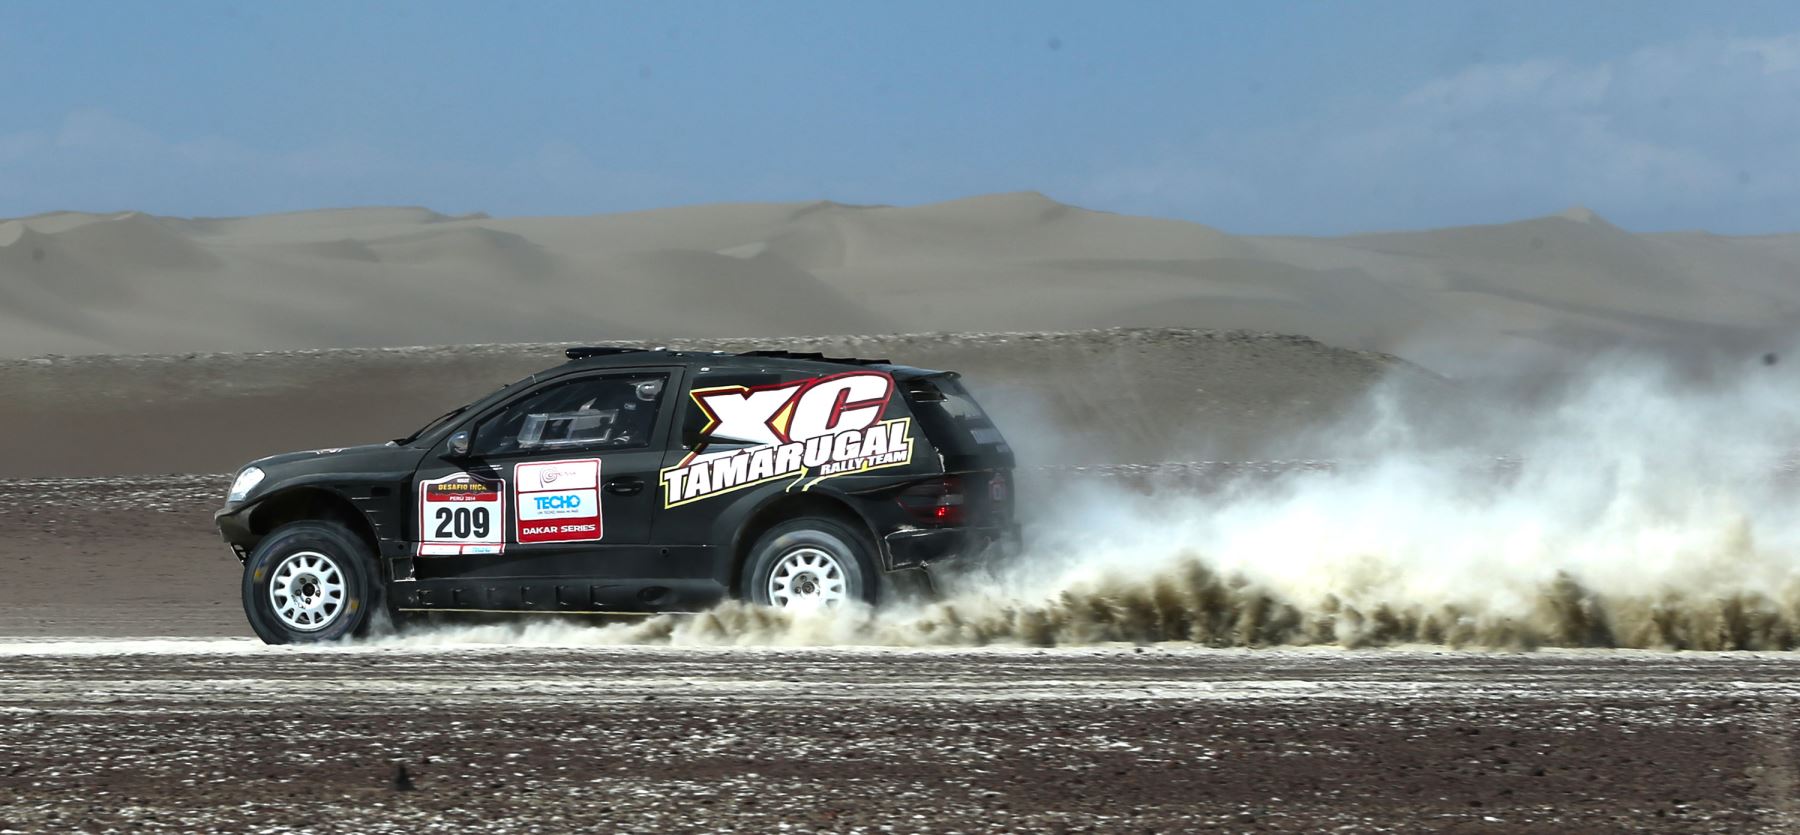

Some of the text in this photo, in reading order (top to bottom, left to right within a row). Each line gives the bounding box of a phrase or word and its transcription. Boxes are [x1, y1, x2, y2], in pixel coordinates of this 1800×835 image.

[690, 371, 894, 450] XC
[662, 421, 909, 503] TAMARUGAL
[820, 450, 908, 476] RALLY TEAM
[534, 495, 580, 510] TECHO
[435, 506, 490, 539] 209
[523, 524, 596, 535] DAKAR SERIES
